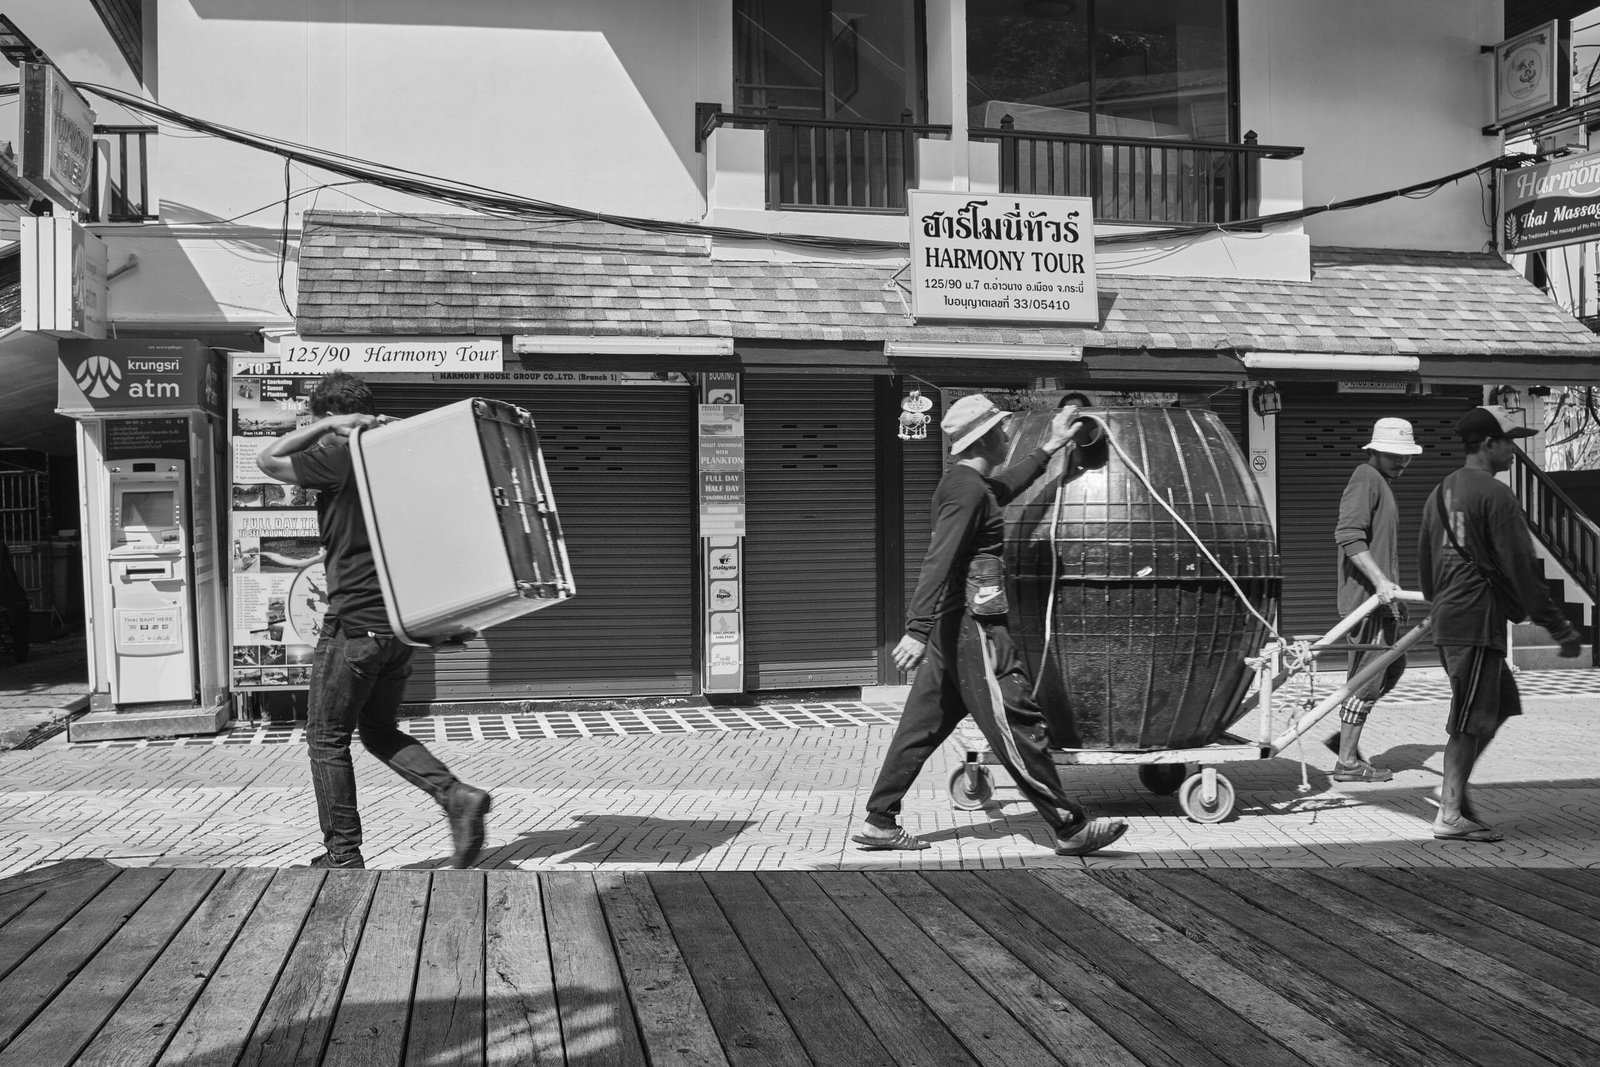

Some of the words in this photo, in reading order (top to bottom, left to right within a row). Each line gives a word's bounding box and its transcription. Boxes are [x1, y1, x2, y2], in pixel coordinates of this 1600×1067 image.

[921, 200, 1080, 243] ฮาร์โมนี่ทัวร์
[1521, 209, 1548, 228] Thai
[1529, 231, 1549, 239] Traditional
[925, 247, 1025, 271] HARMONY
[1031, 252, 1085, 274] TOUR
[924, 278, 962, 289] 125/90
[965, 280, 980, 290] ม.7
[1026, 281, 1054, 292] อ.เมือง
[1056, 280, 1084, 293] จ.กระบี่
[944, 295, 1010, 309] ใบอนุญาตเลขที่
[1013, 298, 1070, 310] 33/05410
[286, 344, 350, 366] 125/90
[363, 345, 447, 366] Harmony
[456, 345, 499, 362] Tour
[128, 359, 180, 372] krungsri
[248, 363, 271, 375] TOP
[440, 372, 480, 380] HARMONY
[483, 372, 511, 380] HOUSE
[578, 373, 608, 381] (Branch
[128, 379, 180, 398] atm
[701, 456, 744, 464] PLANKTON
[242, 517, 271, 529] FULL
[274, 517, 298, 529] DAY
[248, 529, 260, 538] SEE
